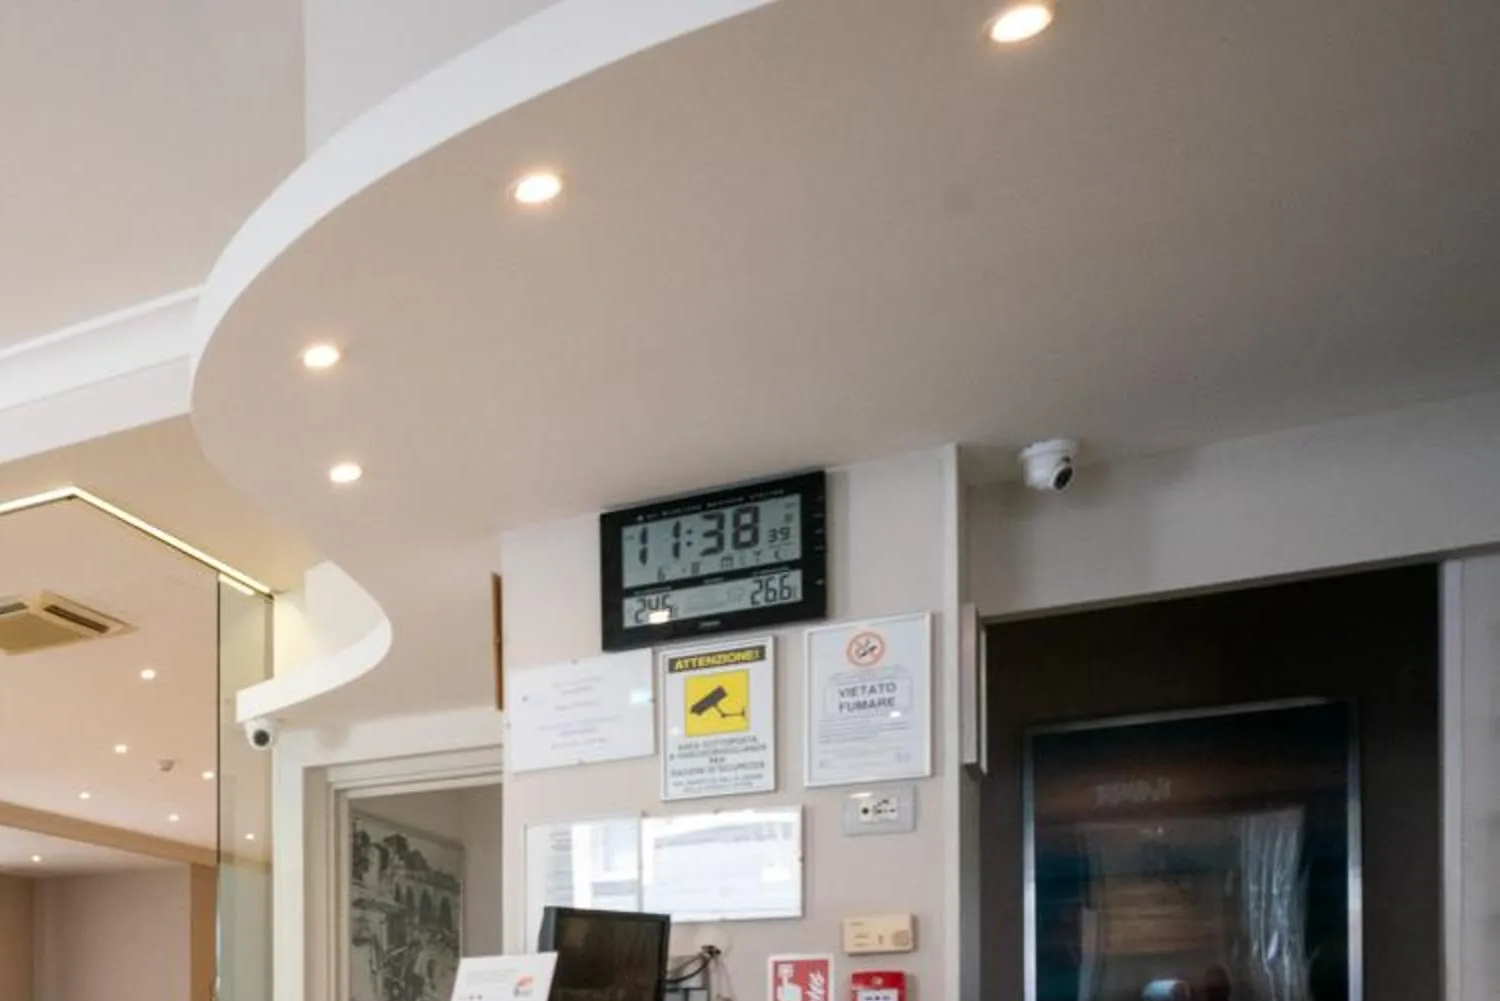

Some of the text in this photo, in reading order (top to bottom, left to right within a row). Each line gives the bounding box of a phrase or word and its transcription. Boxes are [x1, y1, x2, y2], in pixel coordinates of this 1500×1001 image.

[638, 506, 760, 567] 11:38
[838, 682, 898, 698] VIETATO
[838, 696, 896, 713] FUMARE
